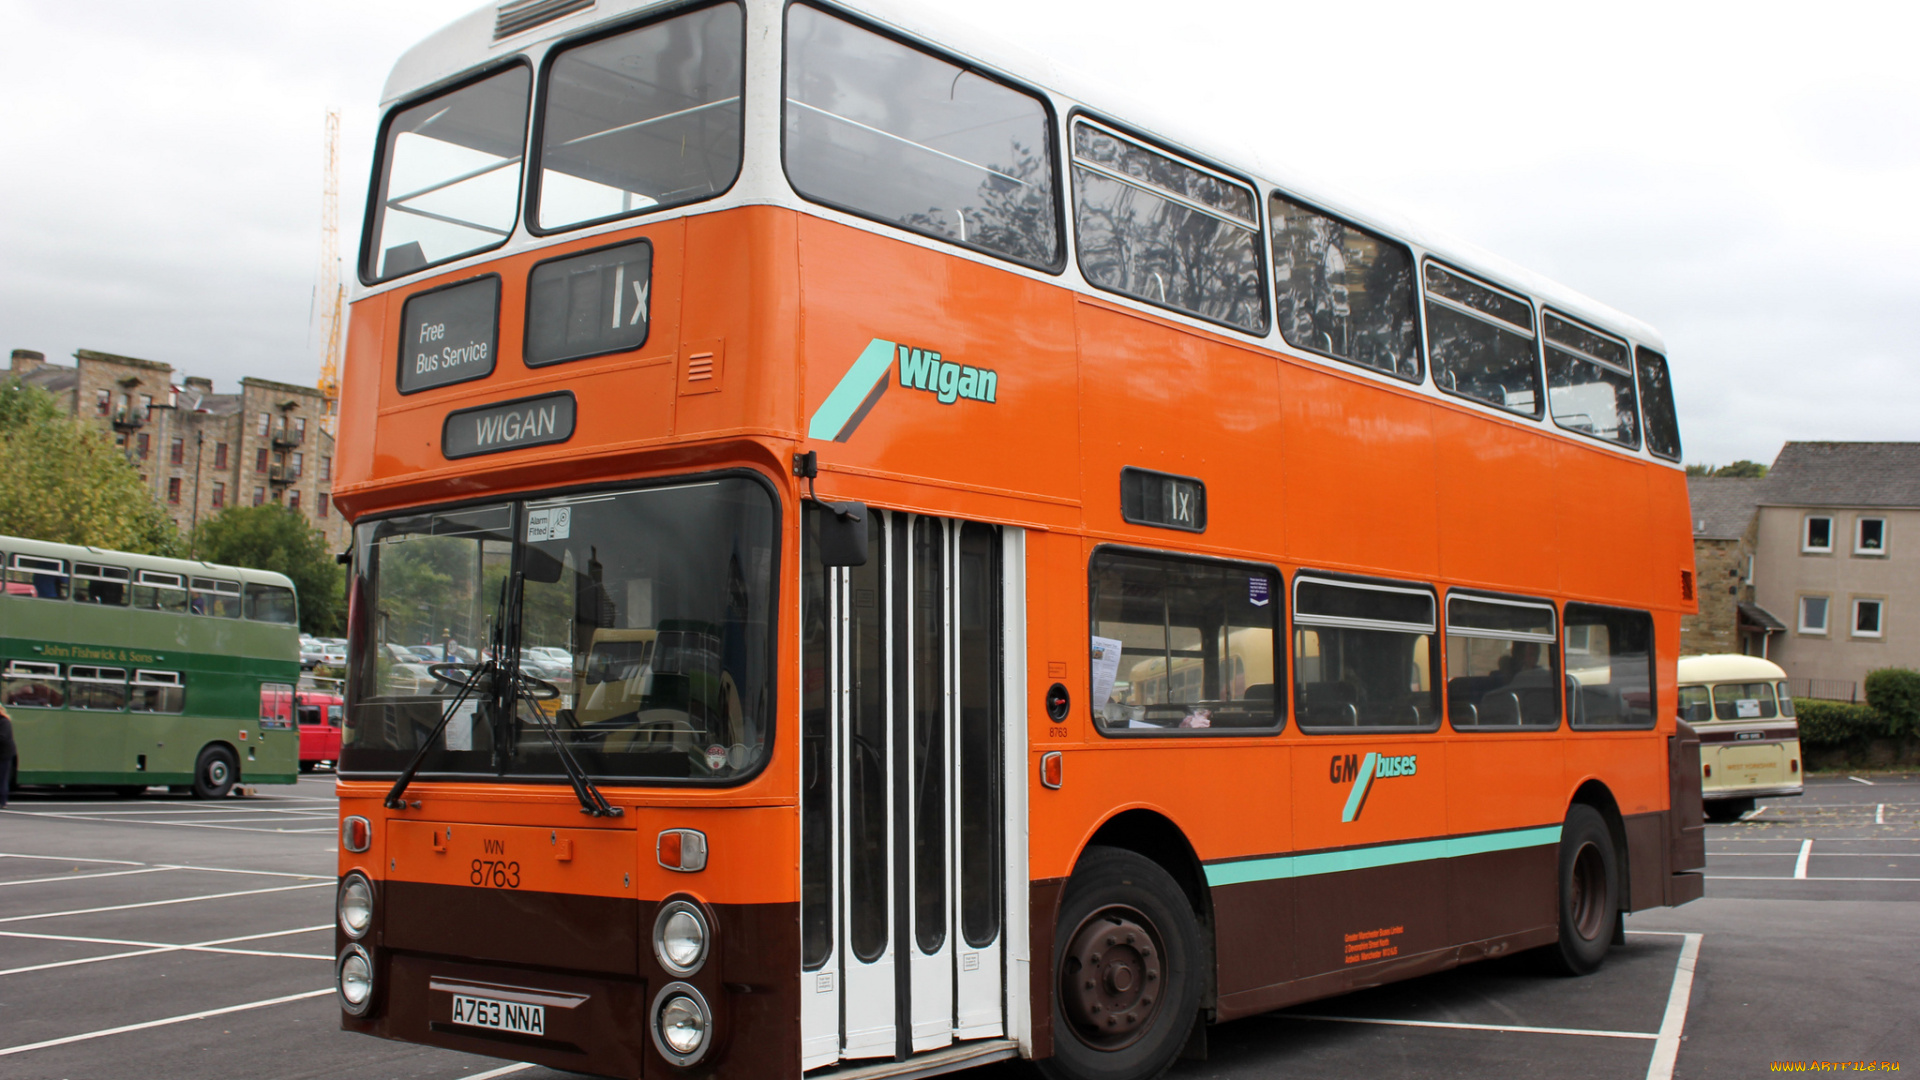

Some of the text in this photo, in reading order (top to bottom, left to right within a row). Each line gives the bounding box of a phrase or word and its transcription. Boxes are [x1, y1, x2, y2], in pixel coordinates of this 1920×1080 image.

[419, 322, 445, 344] Free
[416, 340, 488, 375] Bus Service
[898, 343, 998, 405] Wigan
[476, 404, 556, 446] WIGAN
[529, 527, 547, 536] Fitted
[530, 516, 548, 525] Alarm
[41, 644, 153, 663] John Fishwick & Sons
[1049, 726, 1068, 738] 8763
[1330, 753, 1417, 784] GM buses
[484, 838, 505, 855] WN
[469, 858, 521, 889] 8763
[453, 997, 542, 1033] A763 NNA
